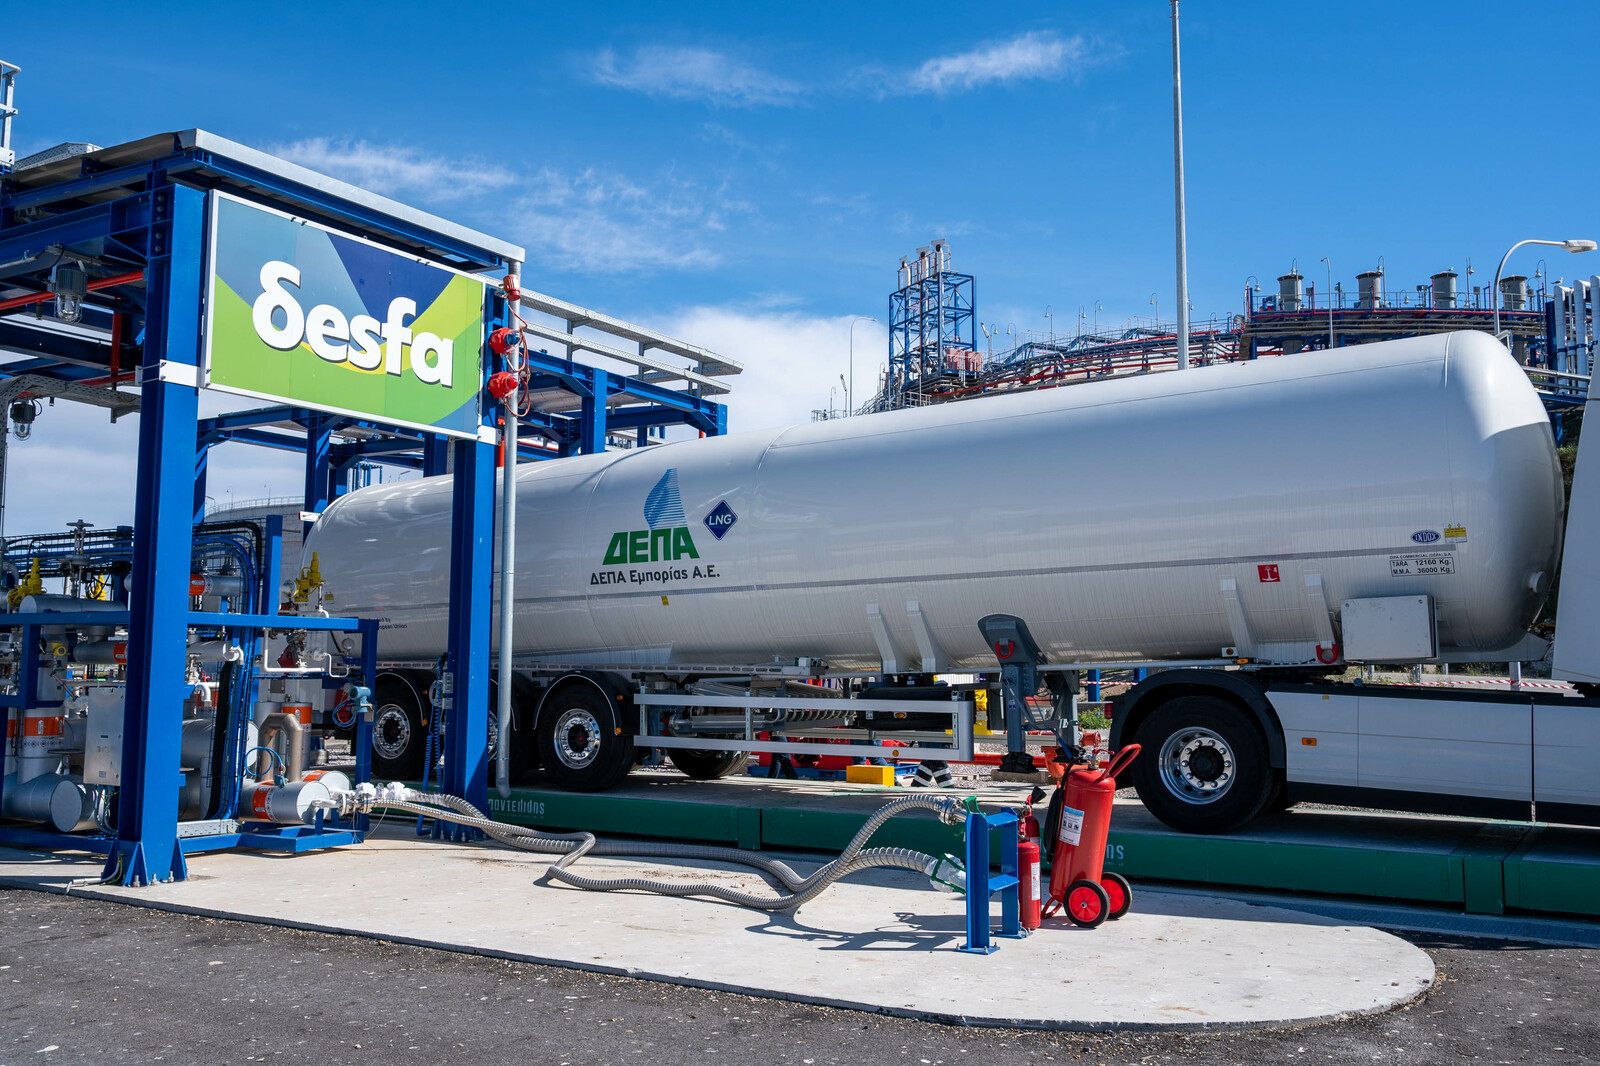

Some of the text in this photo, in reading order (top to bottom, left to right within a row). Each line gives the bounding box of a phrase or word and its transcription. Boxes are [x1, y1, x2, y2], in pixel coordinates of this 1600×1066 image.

[708, 514, 732, 527] LNG
[602, 526, 700, 565] ΔΕΠΑ
[590, 571, 627, 585] ΔΕΠΑ
[629, 567, 688, 586] Εμπορίας
